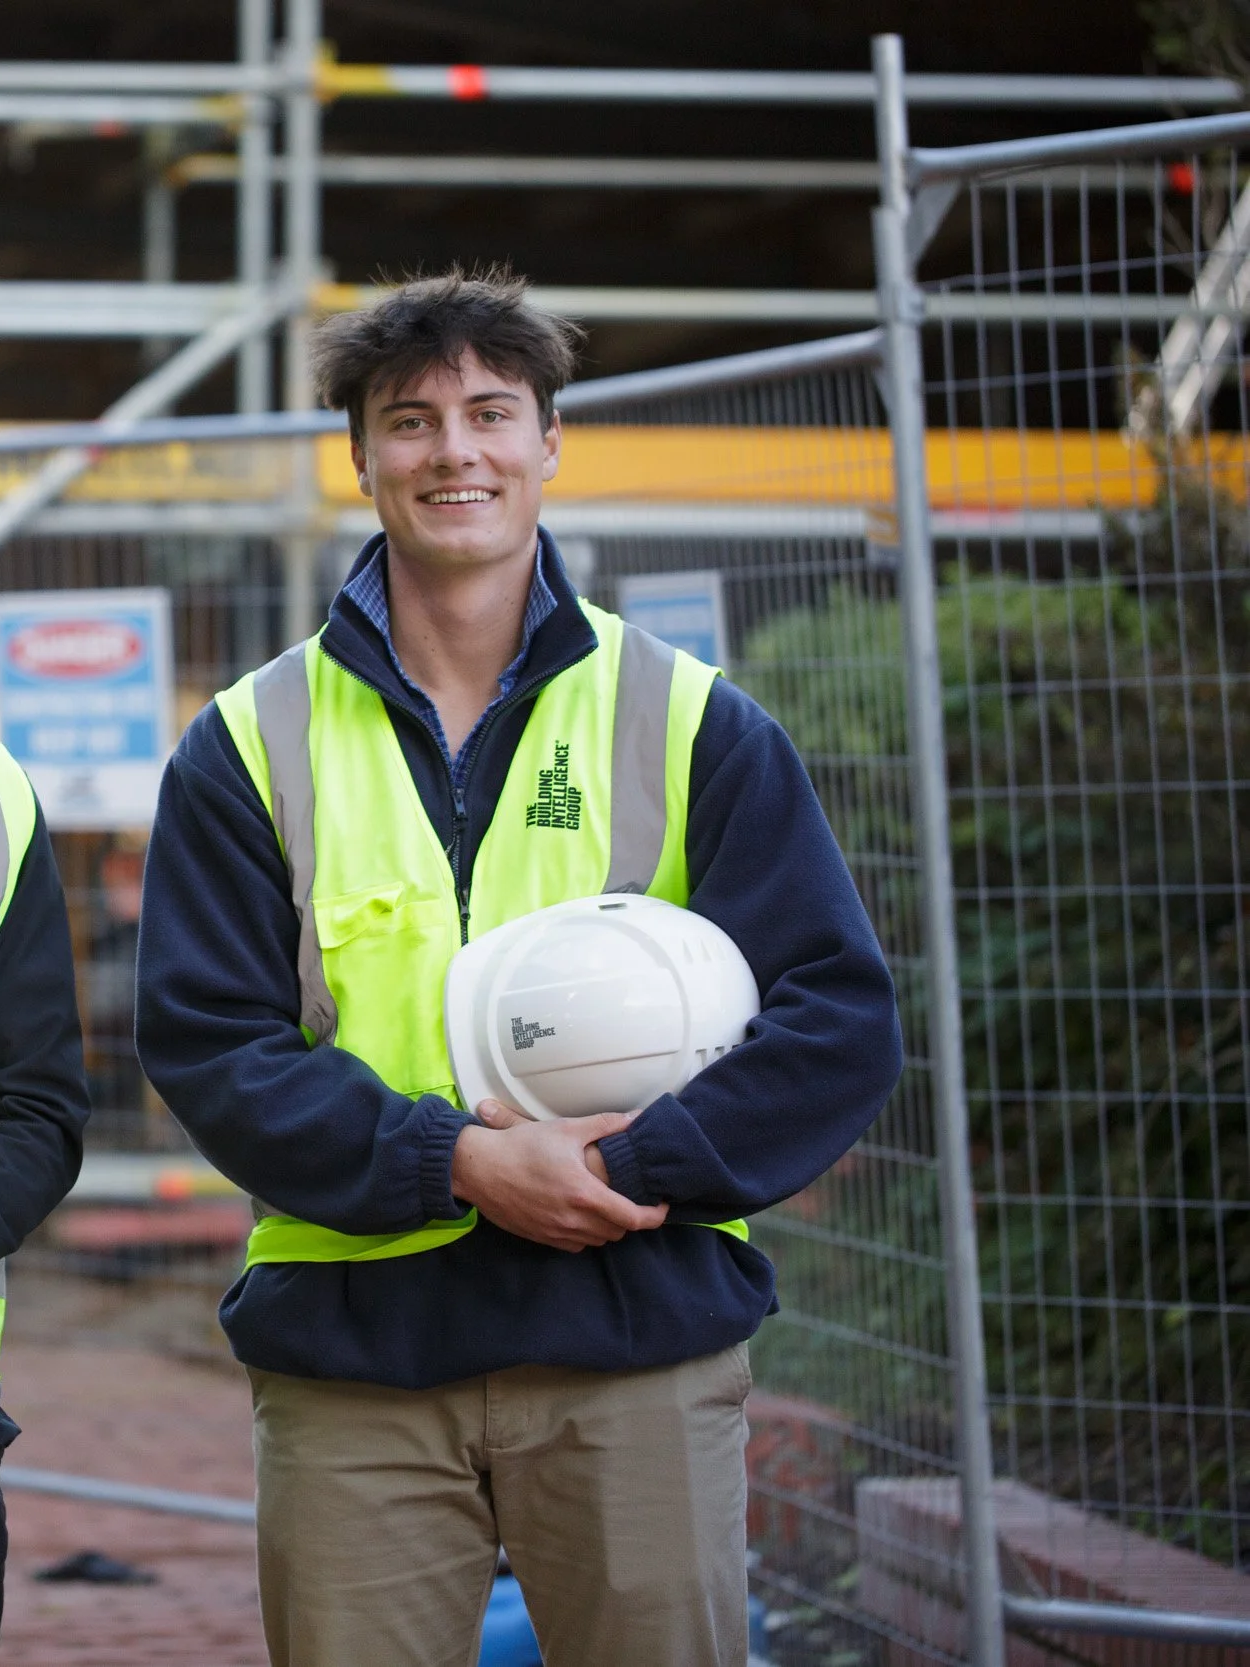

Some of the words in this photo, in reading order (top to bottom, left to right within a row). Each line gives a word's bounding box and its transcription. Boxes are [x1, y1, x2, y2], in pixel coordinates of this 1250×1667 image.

[551, 743, 570, 829] INTELLIGENCE
[536, 769, 553, 828] BUILDING
[565, 786, 582, 831] GROUP
[526, 802, 537, 829] THE
[511, 1016, 523, 1026] THE
[511, 1021, 540, 1035] BUILDING
[512, 1026, 556, 1043] INTELLIGENCE
[514, 1039, 535, 1051] GROUP
